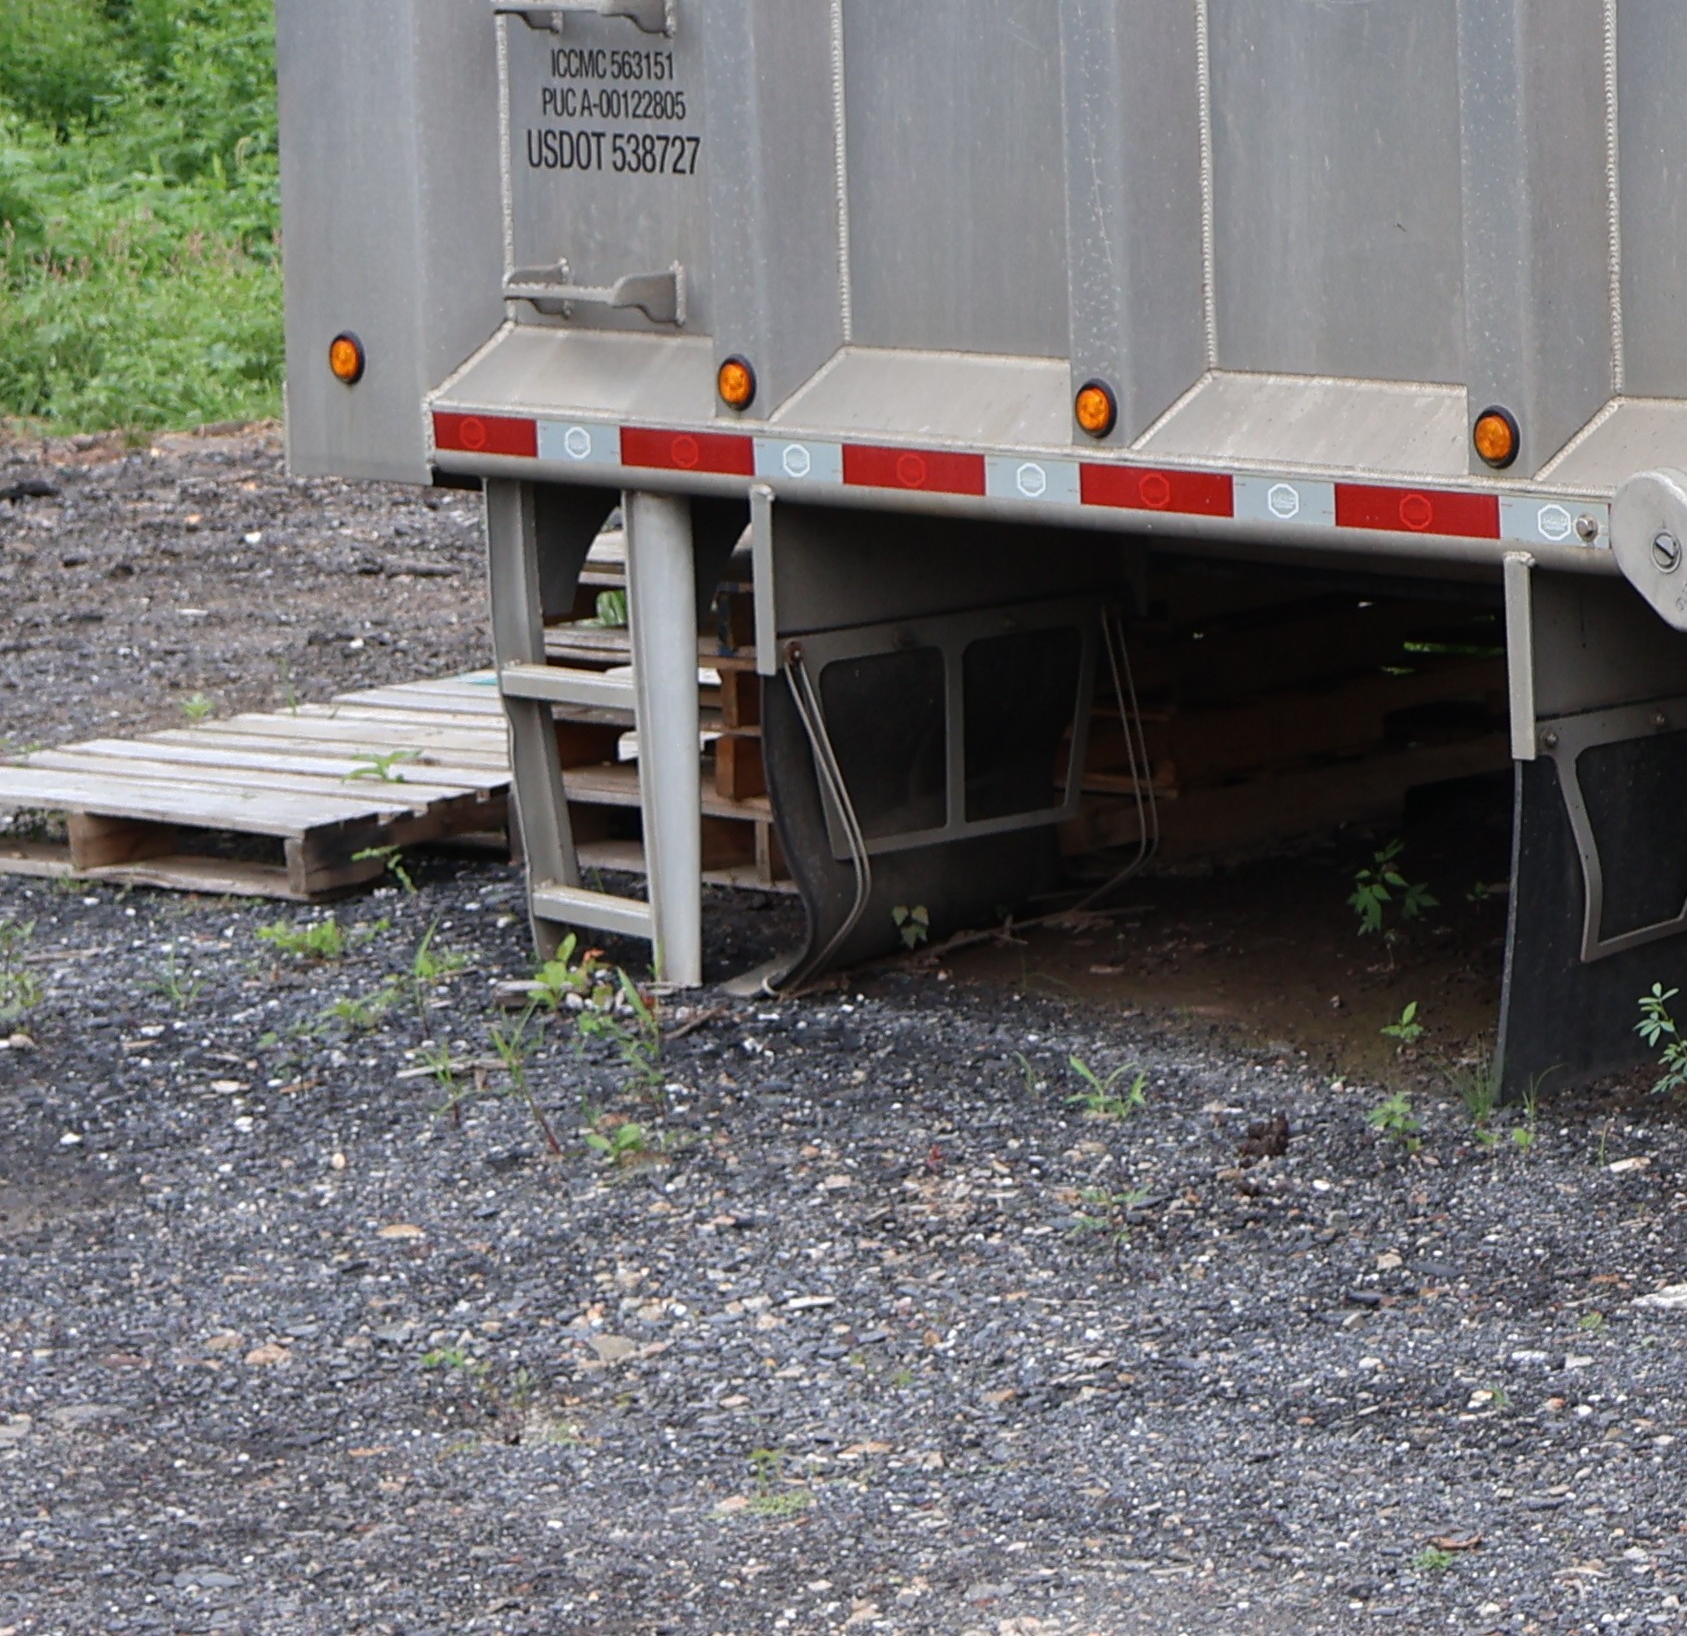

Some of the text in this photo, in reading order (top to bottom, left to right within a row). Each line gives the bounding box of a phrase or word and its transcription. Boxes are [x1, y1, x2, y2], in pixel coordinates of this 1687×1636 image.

[551, 48, 674, 80] ICCMC 563151
[541, 87, 687, 120] PUC A-00122805
[527, 129, 701, 175] USDOT 538727
